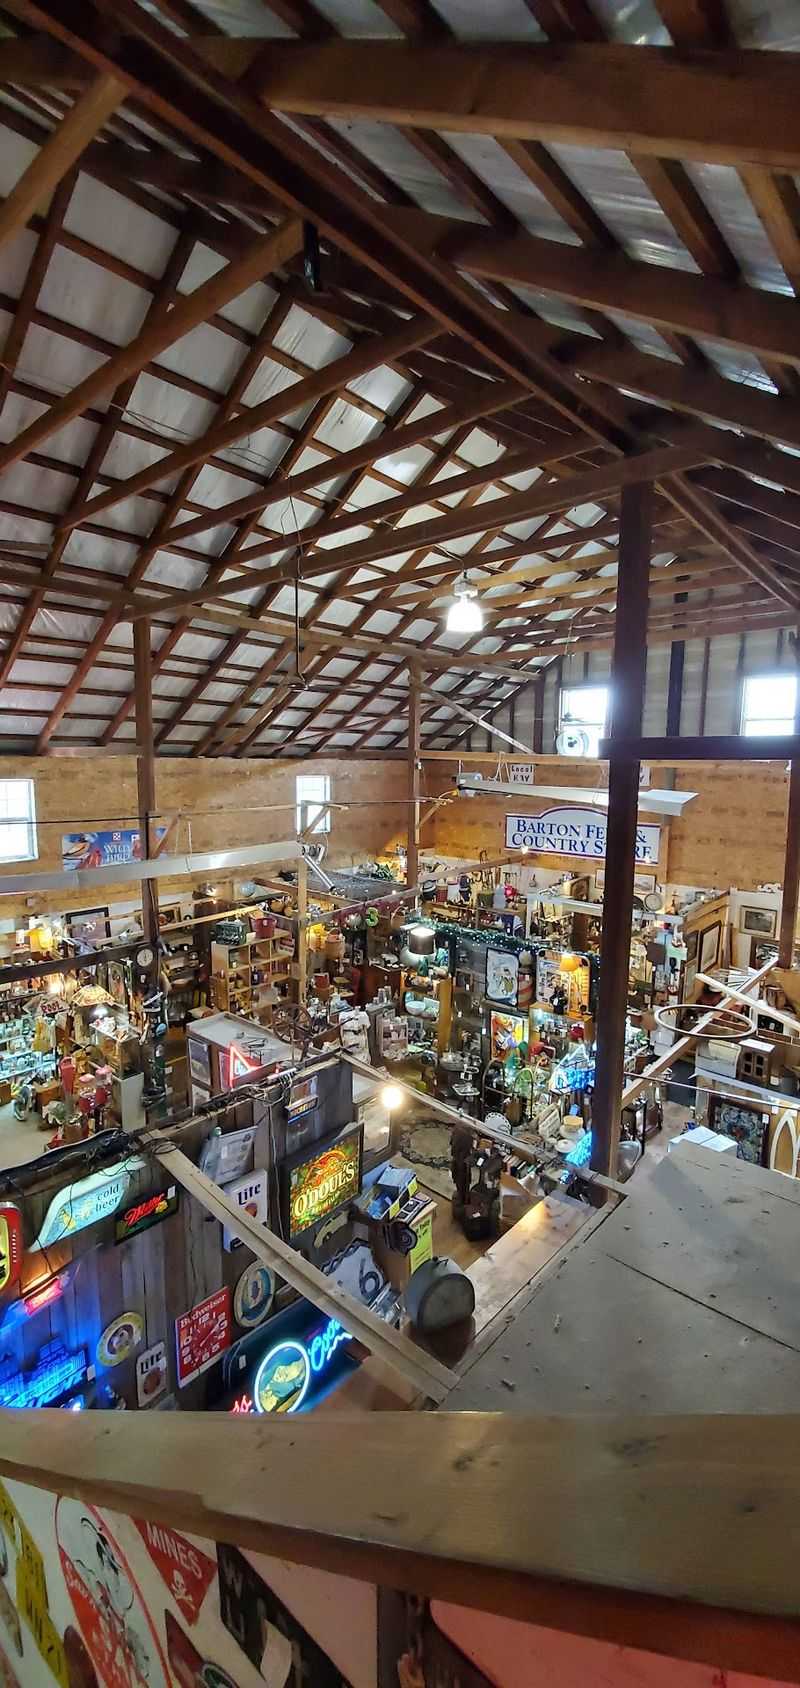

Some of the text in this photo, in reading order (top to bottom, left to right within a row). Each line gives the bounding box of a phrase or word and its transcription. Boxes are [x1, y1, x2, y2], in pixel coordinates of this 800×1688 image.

[517, 819, 580, 837] BARTON
[586, 824, 608, 840] FE
[512, 832, 652, 860] COUNTRY SRE
[95, 1195, 120, 1212] beer
[97, 1183, 119, 1201] cold
[237, 1183, 261, 1206] Lite
[180, 1294, 227, 1329] Budweiser
[308, 1317, 342, 1372] Coo
[140, 1351, 163, 1375] Lite
[146, 1520, 203, 1580] MINES
